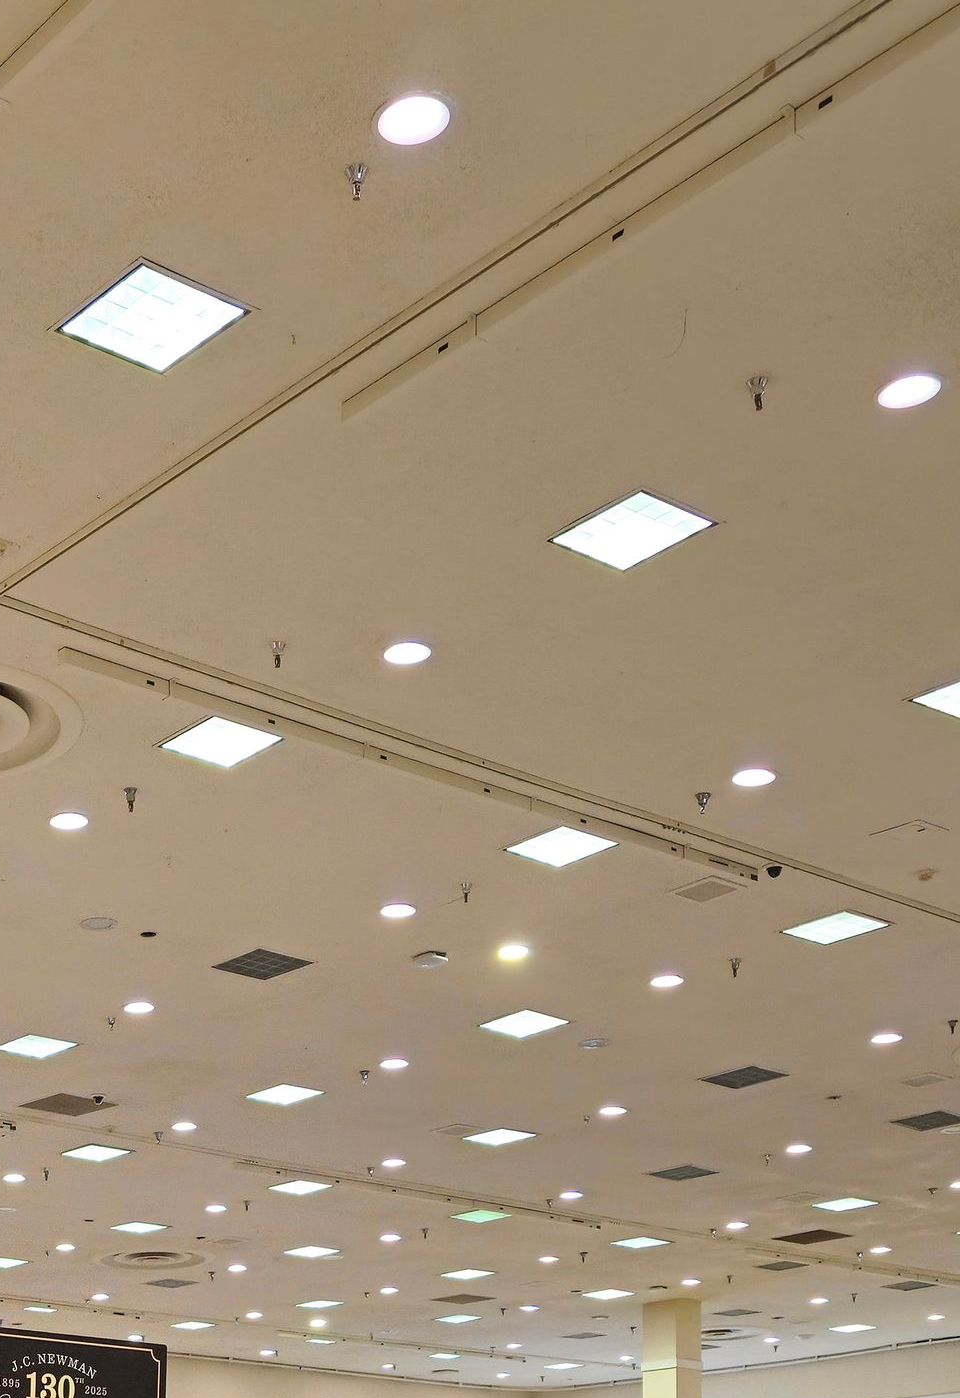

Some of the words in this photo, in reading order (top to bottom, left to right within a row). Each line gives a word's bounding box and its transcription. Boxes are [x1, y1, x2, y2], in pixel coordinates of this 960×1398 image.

[11, 1355, 35, 1373] J.C.
[37, 1353, 98, 1380] NEWMAN
[84, 1385, 108, 1396] 2025
